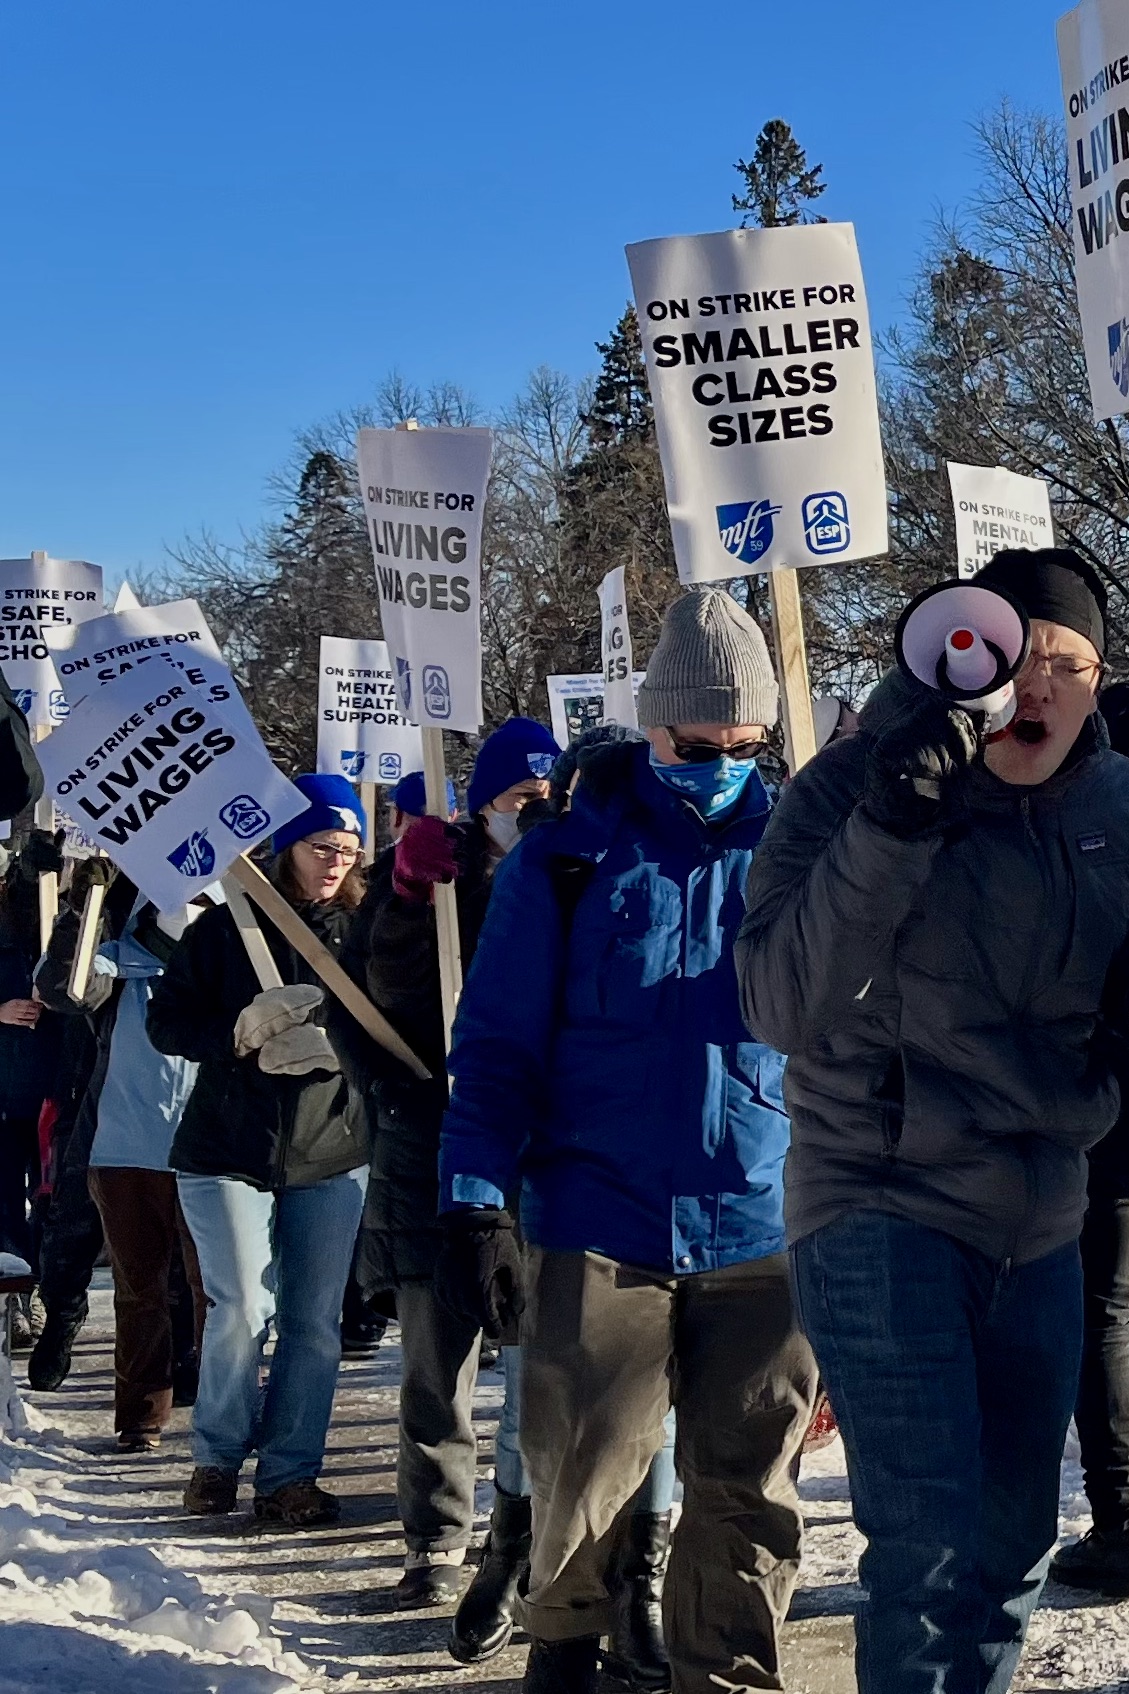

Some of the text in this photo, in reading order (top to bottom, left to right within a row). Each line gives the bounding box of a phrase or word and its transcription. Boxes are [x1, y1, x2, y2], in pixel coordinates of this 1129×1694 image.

[1069, 89, 1089, 118] ON
[1090, 55, 1129, 106] STRIKE
[646, 284, 856, 322] ON STRIKE FOR
[652, 318, 860, 368] SMALLER
[692, 361, 838, 406] CLASS
[708, 404, 834, 447] SIZES
[367, 485, 475, 512] ON STRIKE FOR
[959, 500, 1047, 528] ON STRIKE FOR
[373, 518, 467, 564] LIVING
[750, 540, 764, 551] 59
[817, 525, 840, 540] ESP
[972, 519, 1039, 547] MENTAL
[5, 589, 97, 601] STRIKE FOR
[376, 564, 471, 613] WAGES
[1, 605, 73, 625] SAFE,
[60, 631, 202, 675] ON STRIKE FOR
[325, 666, 393, 680] ON STRIKE
[57, 686, 186, 795] ON STRIKE FOR
[77, 707, 205, 820] LIVING
[98, 727, 236, 845] WAGES
